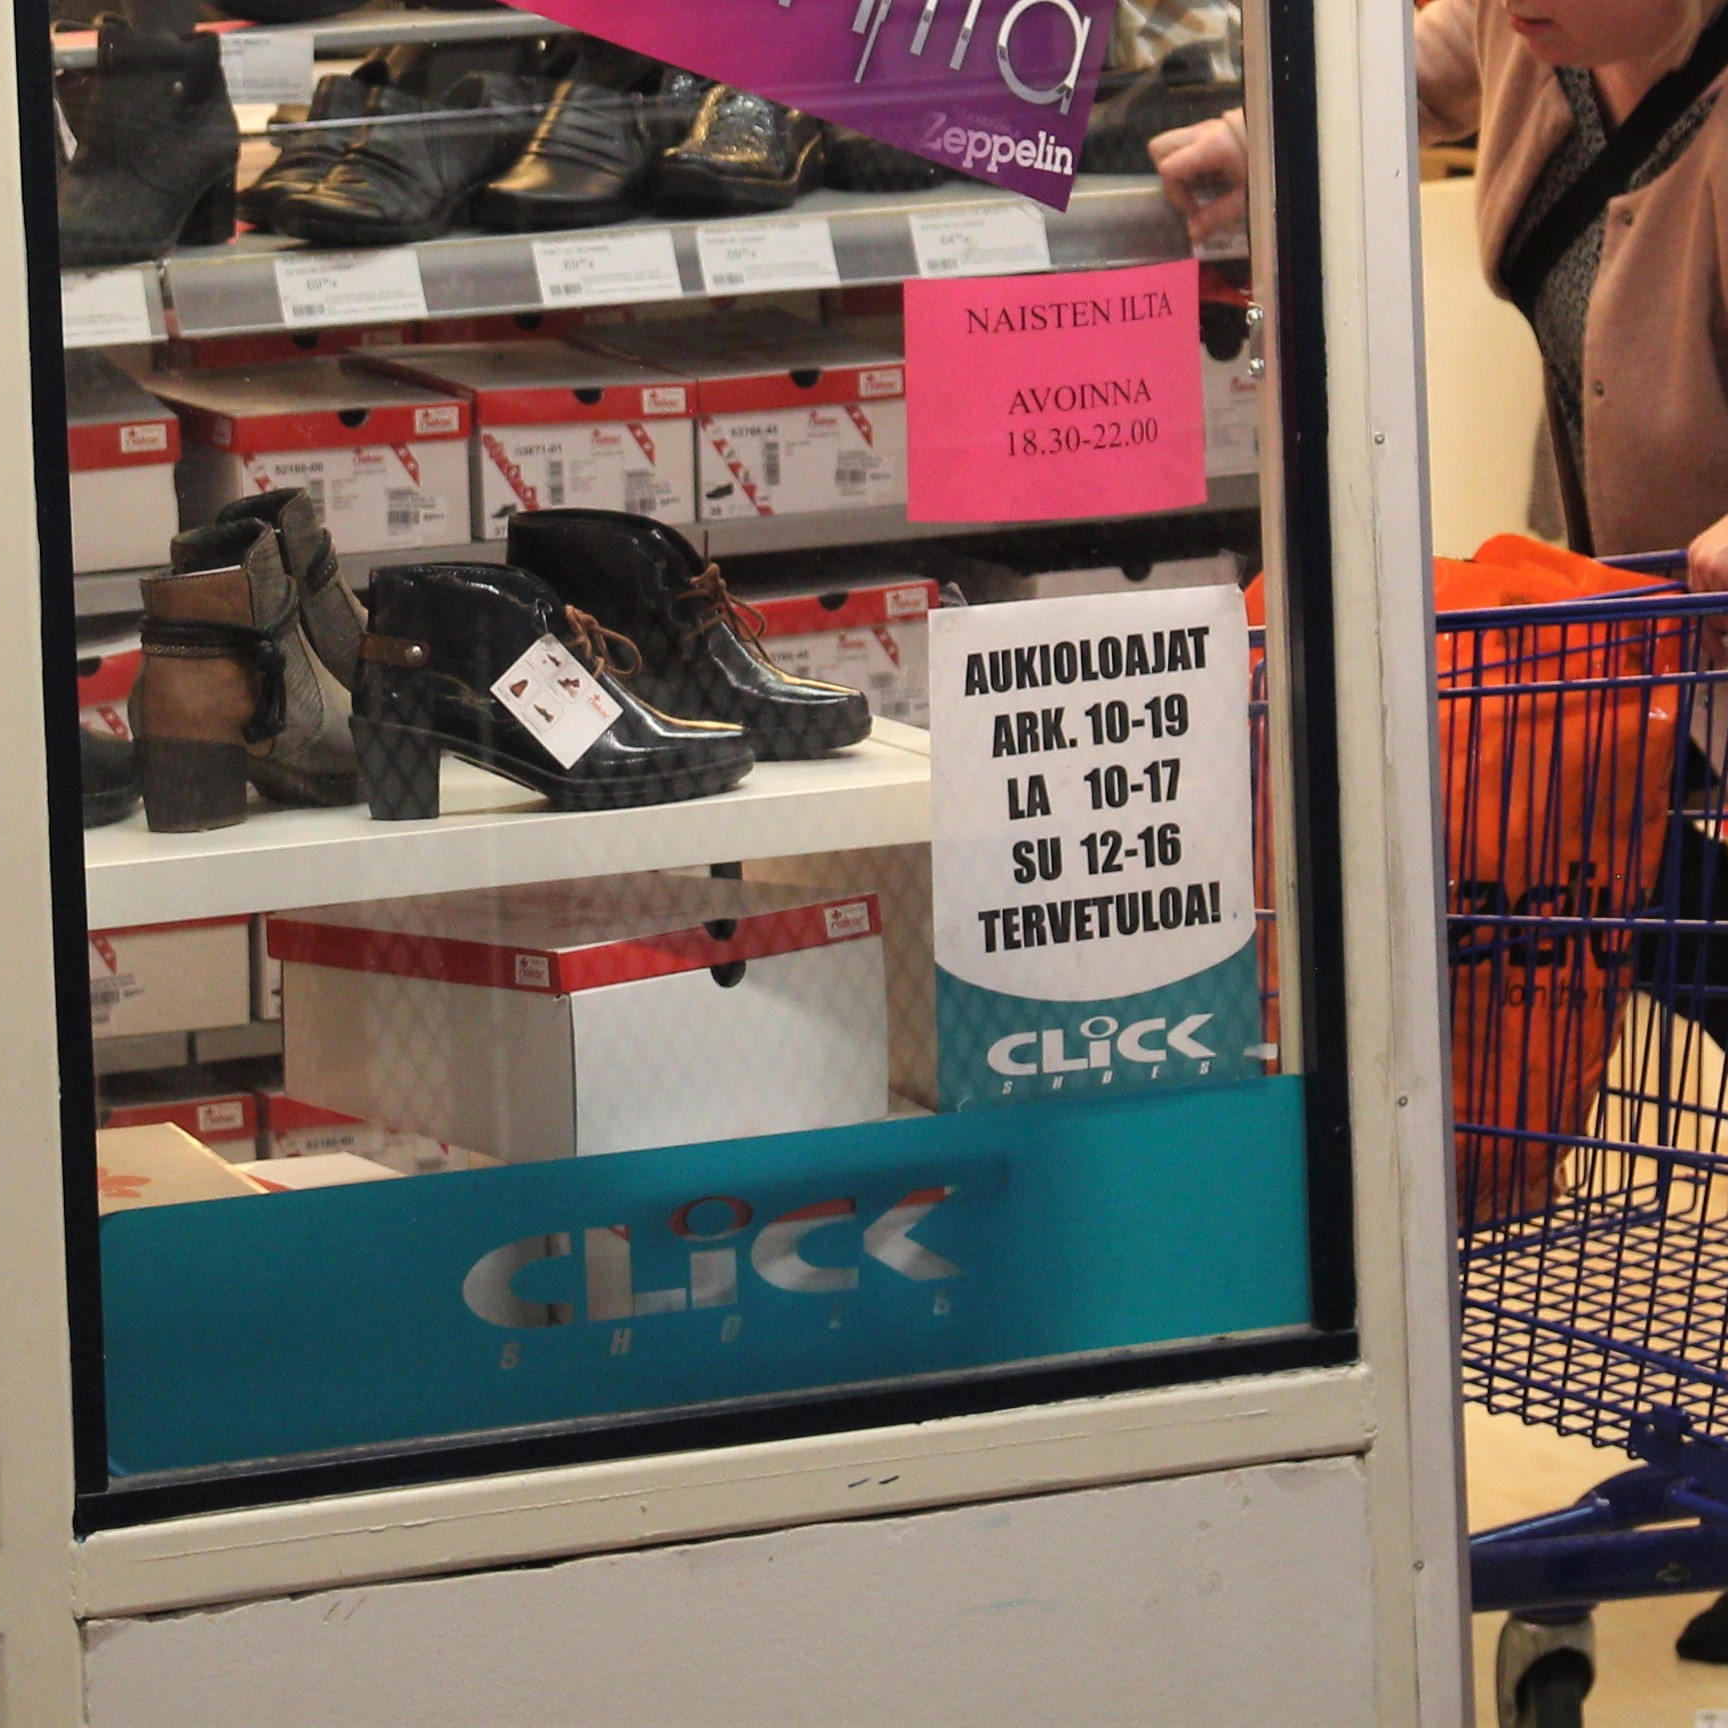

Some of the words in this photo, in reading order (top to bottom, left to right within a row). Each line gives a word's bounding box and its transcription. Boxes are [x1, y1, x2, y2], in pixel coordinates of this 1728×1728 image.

[923, 110, 1075, 177] Zeppelin
[966, 298, 1112, 334] NAISTEN
[1120, 290, 1174, 322] ILTA
[1009, 378, 1154, 415] AVOINNA
[1007, 417, 1159, 458] 18.30-22.00
[964, 626, 1211, 697] AUKIOLOAJAT
[991, 709, 1078, 758] ARK.
[1085, 692, 1190, 747] 10-19
[1007, 773, 1050, 821] LA
[1084, 758, 1182, 811] 10-17
[1012, 835, 1063, 884] SU
[1080, 823, 1183, 876] 12-16
[978, 880, 1222, 954] TERVETULOA!
[1003, 1060, 1213, 1095] SHOES
